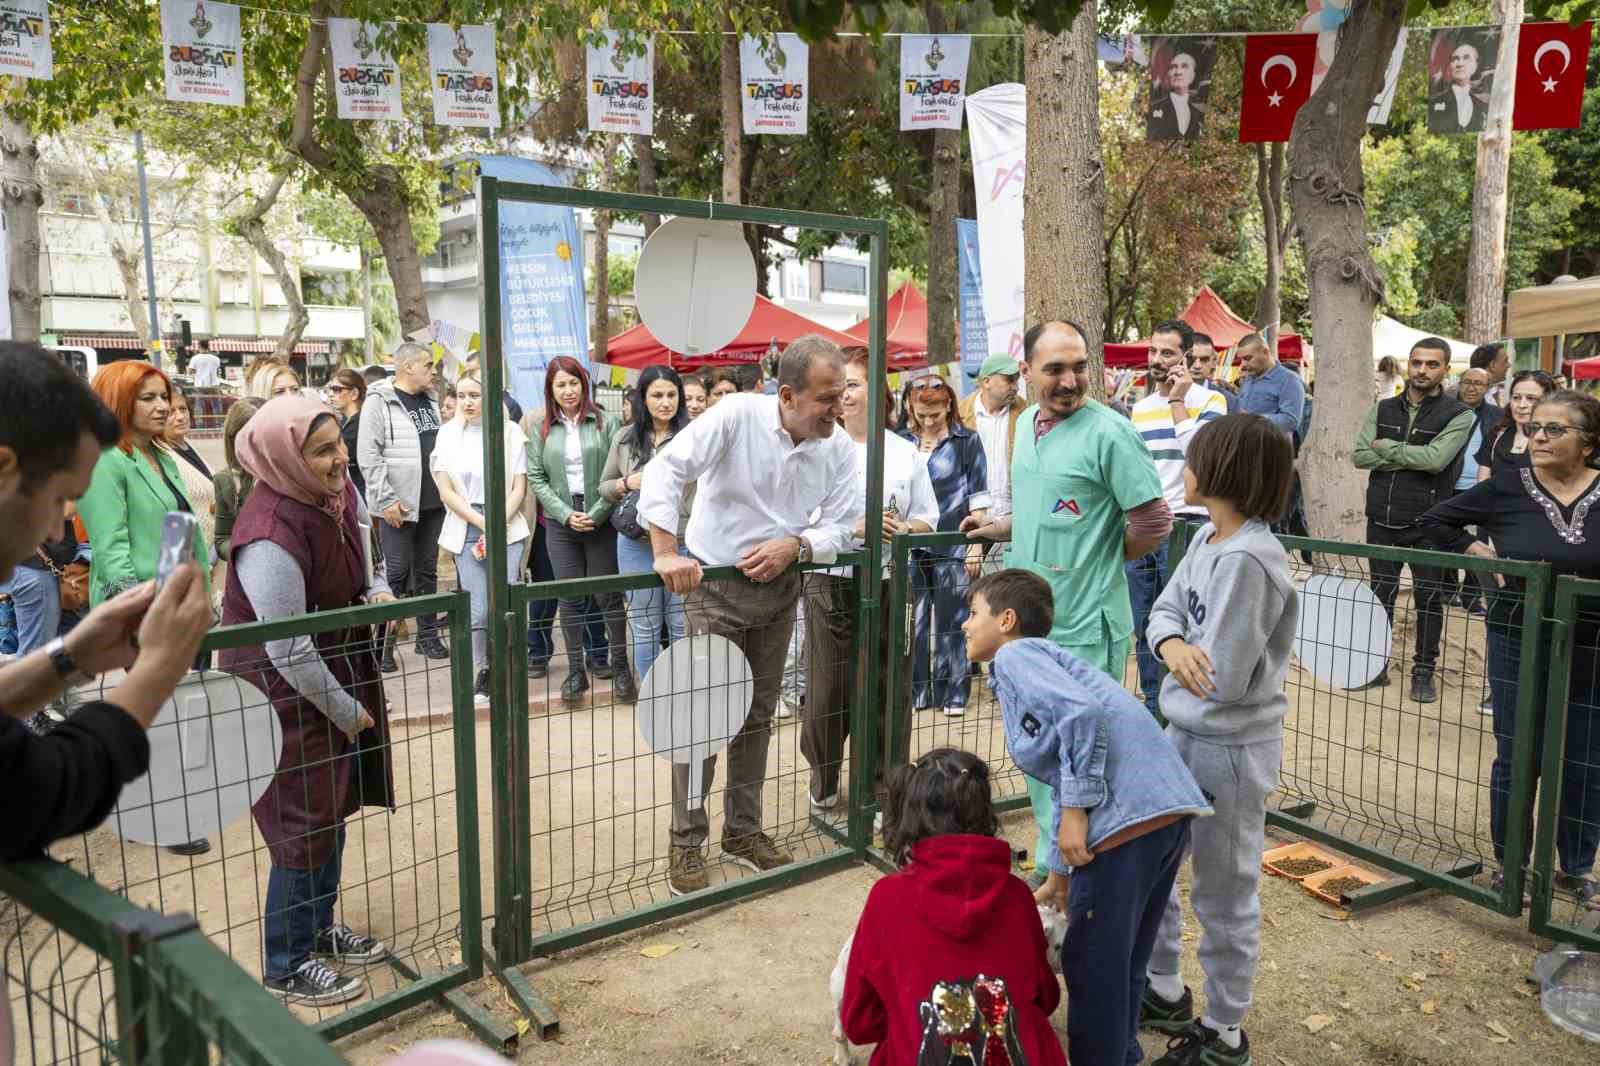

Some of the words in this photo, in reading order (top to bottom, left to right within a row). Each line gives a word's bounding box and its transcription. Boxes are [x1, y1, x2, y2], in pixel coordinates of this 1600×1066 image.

[437, 73, 493, 92] TARSUS
[592, 79, 649, 98] TARSUS
[747, 83, 803, 100] TARSUS
[905, 79, 961, 97] TARSUS
